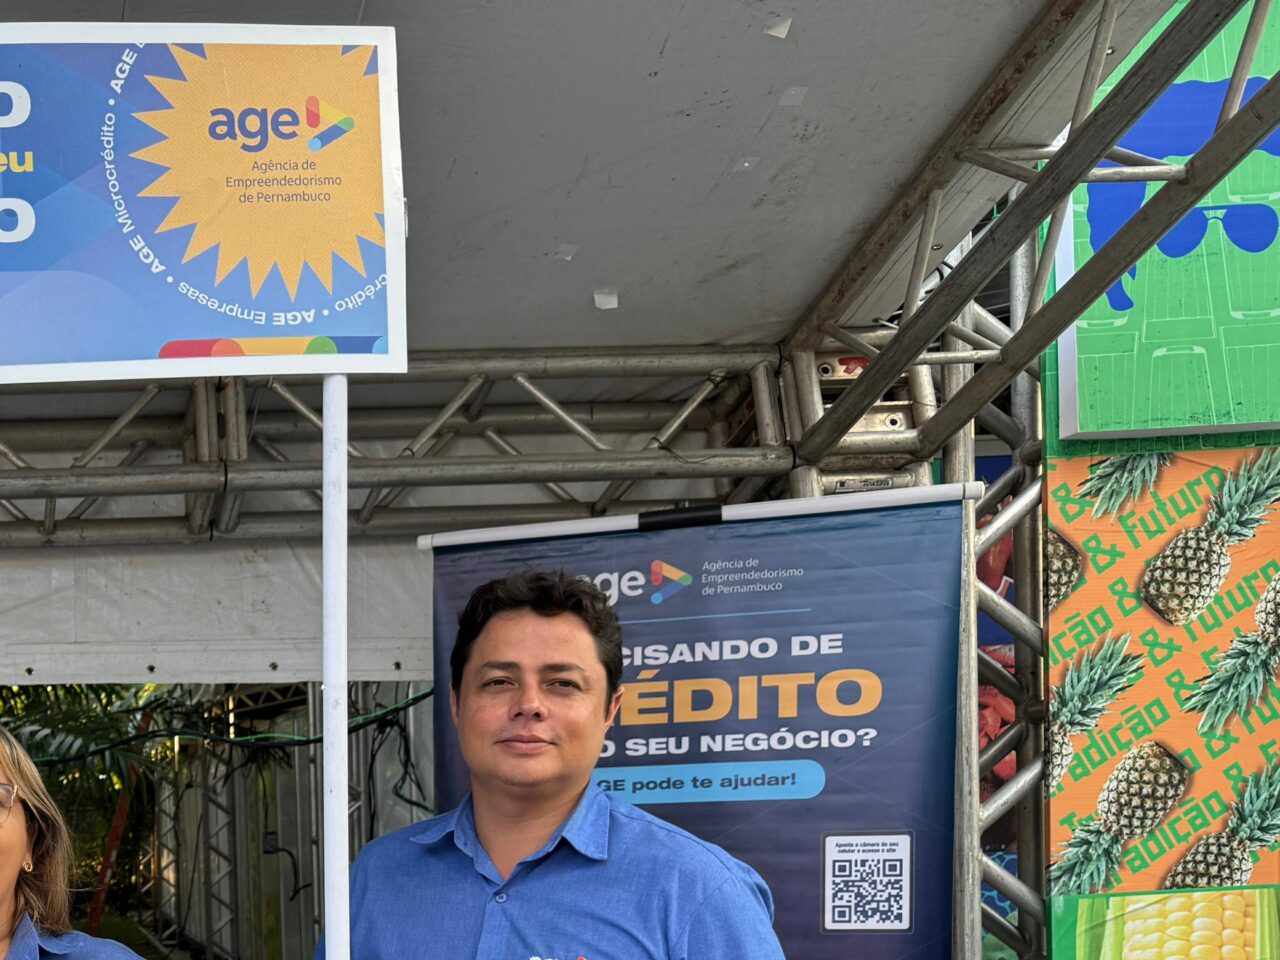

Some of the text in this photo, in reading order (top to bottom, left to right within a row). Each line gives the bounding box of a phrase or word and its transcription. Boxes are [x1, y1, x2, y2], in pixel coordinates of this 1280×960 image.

[109, 48, 138, 95] AGE
[208, 106, 301, 153] age
[251, 159, 317, 173] Agência de
[100, 111, 168, 276] AGE Microcrédito
[225, 175, 342, 190] Empreendedorismo
[238, 190, 332, 204] de Pernambuco
[177, 280, 317, 325] AGE Empresas
[702, 557, 760, 572] Agência de
[1081, 533, 1126, 575] &
[701, 567, 804, 584] Empreendedorismo
[701, 580, 783, 596] de Pernambuco
[790, 633, 844, 657] DE
[1138, 627, 1183, 669] &
[620, 668, 883, 726] ÉDITO
[625, 735, 690, 757] SEU
[700, 726, 879, 754] NEGÓCIO?
[632, 776, 685, 794] pode
[691, 775, 714, 790] te
[719, 772, 797, 791] ajudar!
